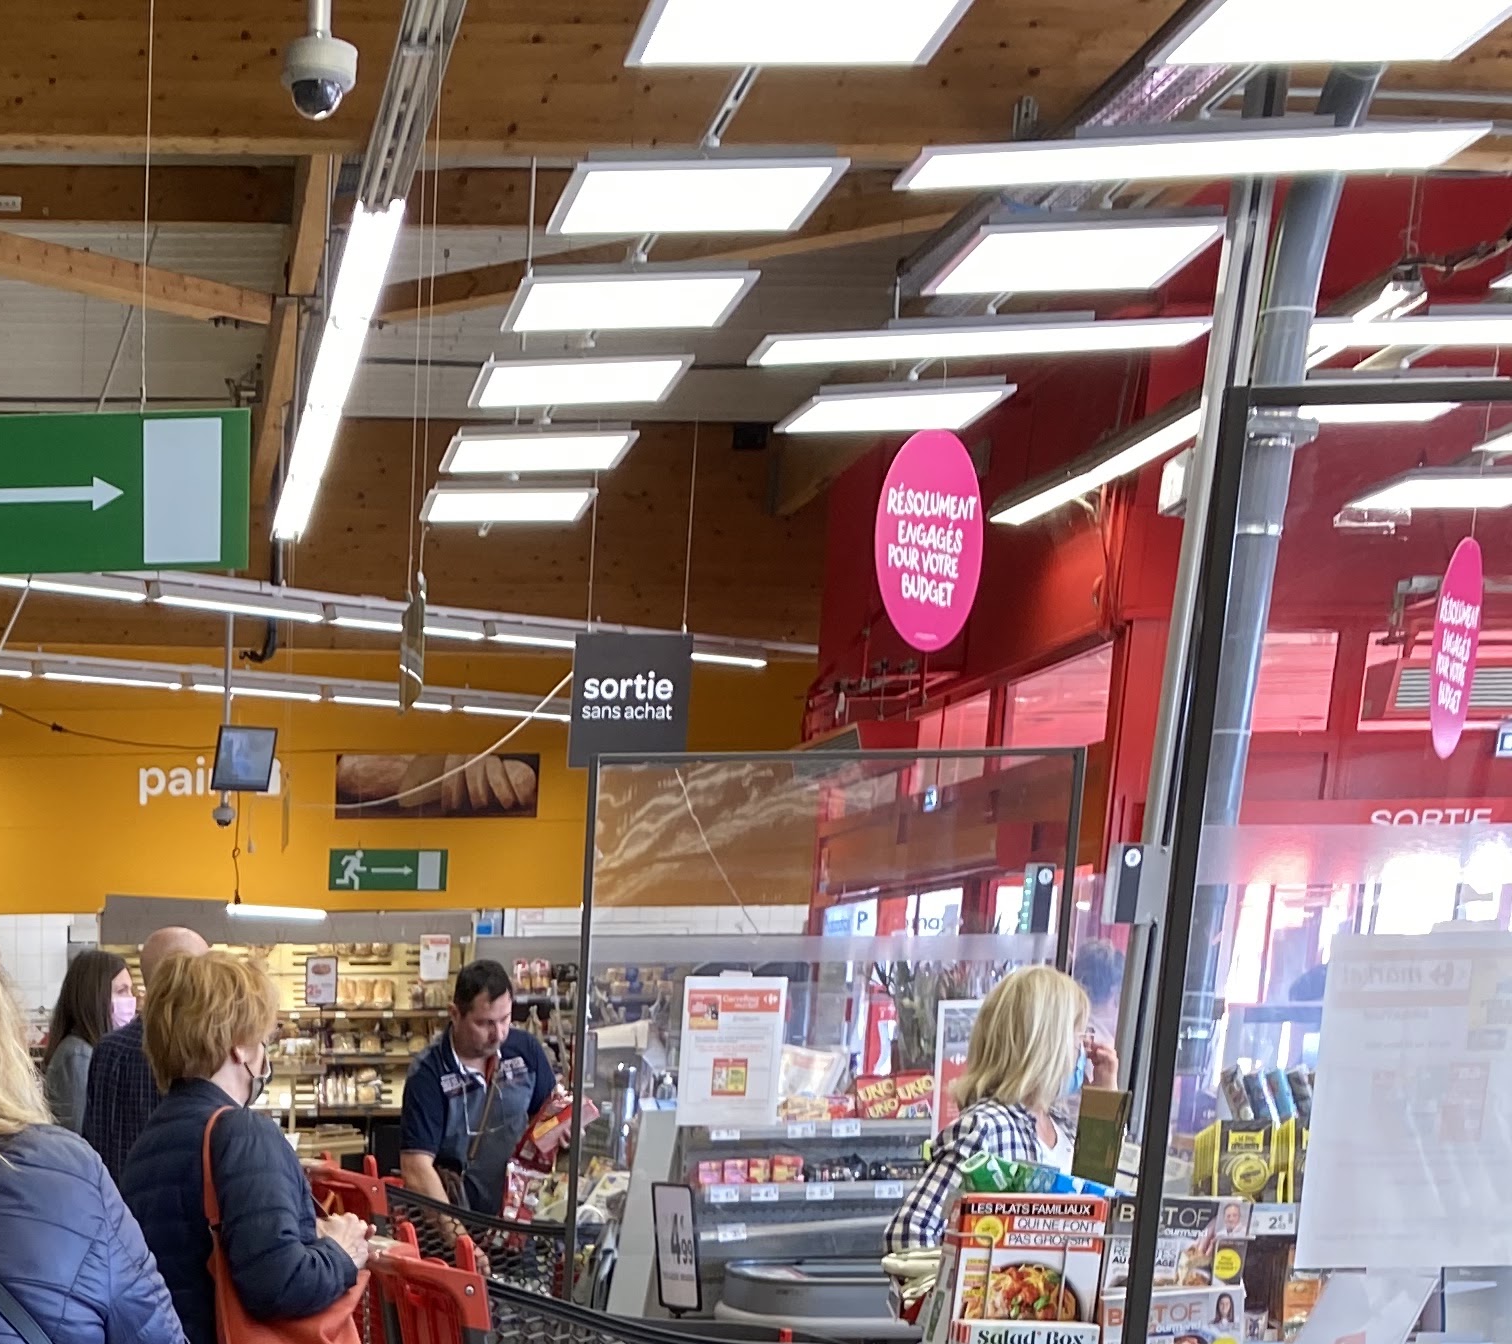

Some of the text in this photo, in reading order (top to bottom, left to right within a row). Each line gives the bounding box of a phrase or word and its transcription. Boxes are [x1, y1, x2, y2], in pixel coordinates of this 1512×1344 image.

[886, 486, 977, 521] RÉSOLUMENT
[897, 520, 963, 555] ENGAGÉS
[888, 542, 960, 579] POUR VOTRE
[901, 572, 955, 608] BUDGET
[583, 671, 674, 702] sortie
[582, 702, 673, 721] sans achat
[139, 755, 233, 806] pai
[859, 1075, 934, 1101] UNO UNO
[868, 1098, 899, 1119] UNO
[971, 1203, 1092, 1216] LES PLATS FAMILIAUX
[1179, 1206, 1212, 1228] OF
[1017, 1218, 1096, 1233] QUI NE FONT
[1008, 1233, 1030, 1246] PAS
[1169, 1302, 1202, 1322] OF
